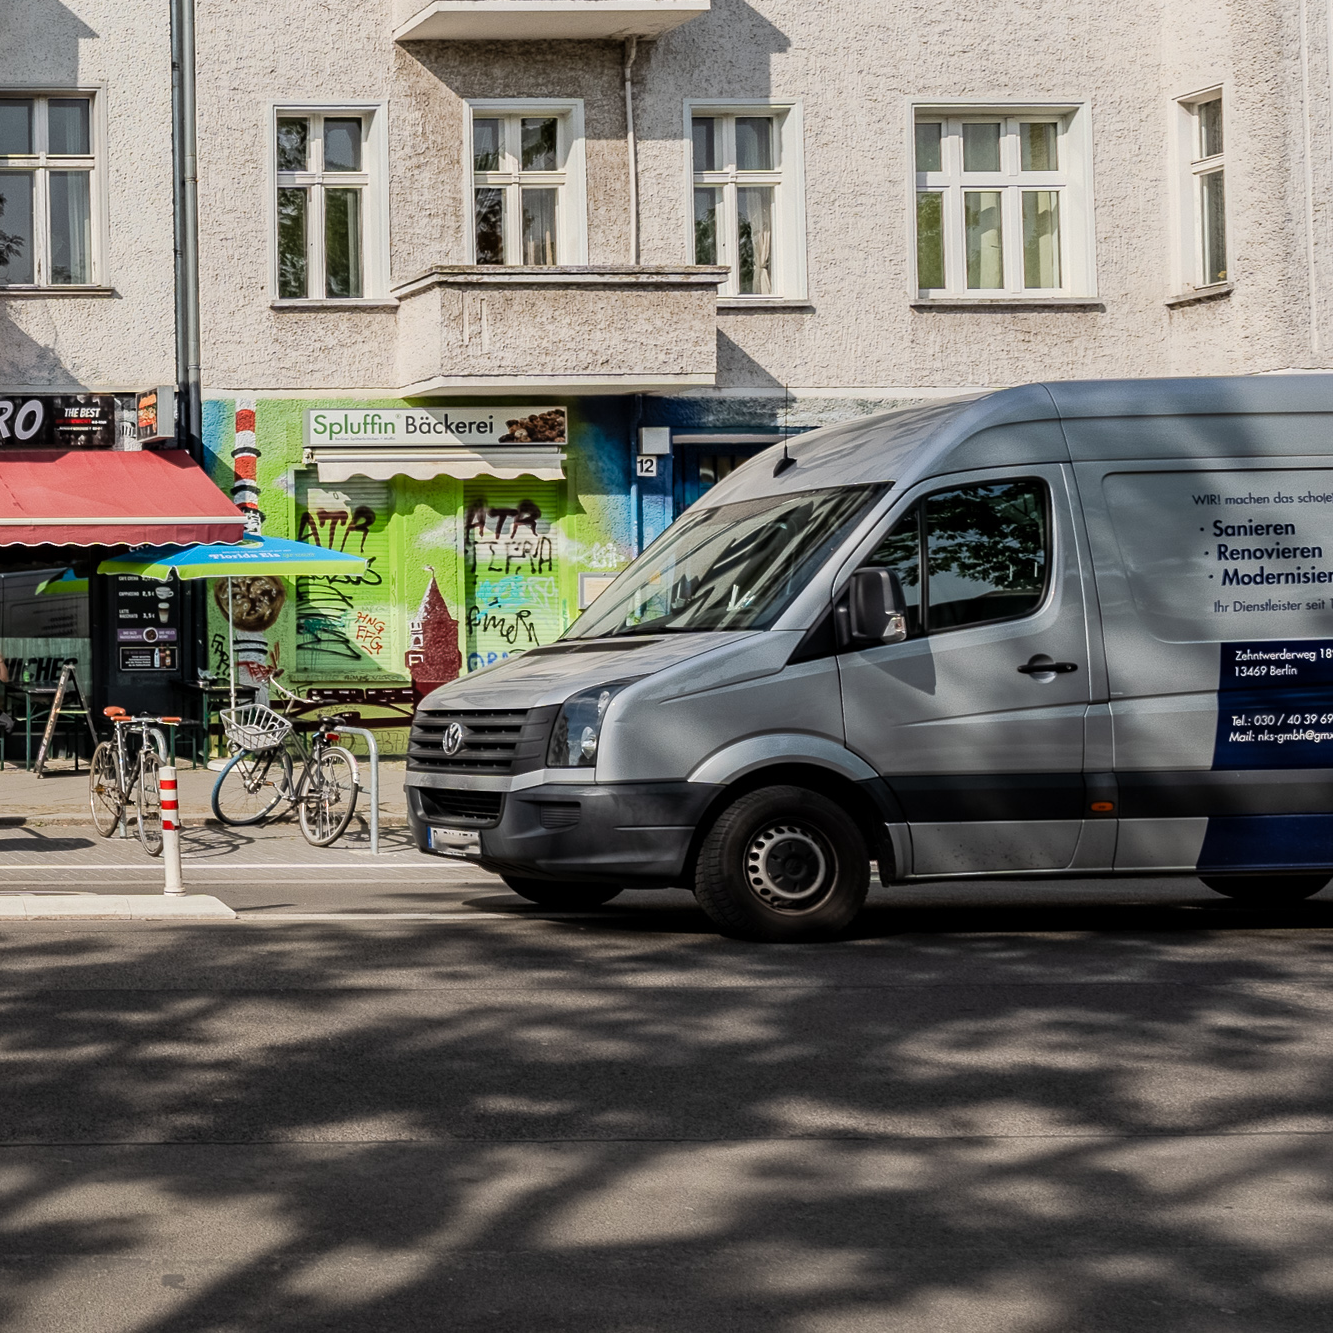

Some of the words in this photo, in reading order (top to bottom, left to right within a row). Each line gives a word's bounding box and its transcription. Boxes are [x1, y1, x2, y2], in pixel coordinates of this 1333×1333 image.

[64, 407, 80, 418] THE
[80, 407, 101, 418] BEST
[405, 415, 494, 434] Bäckerei
[637, 458, 654, 474] 12
[1192, 494, 1221, 505] WIR!
[1225, 492, 1270, 505] machen
[1273, 491, 1294, 504] das
[1213, 518, 1296, 537] Sanieren
[1217, 542, 1323, 561] Renovieren
[1214, 599, 1230, 613] Ihr
[1233, 599, 1302, 613] Dienstleister
[1305, 599, 1326, 610] seit
[1235, 648, 1317, 662] Zehntwerderweg
[1235, 666, 1268, 677] 13469
[1269, 664, 1298, 676] Berlin
[1231, 714, 1252, 726] Tel.:
[1253, 715, 1275, 726] 030
[1277, 713, 1285, 726] /
[1287, 714, 1302, 725] 40
[1303, 714, 1318, 725] 39
[1228, 729, 1255, 743] Mail:
